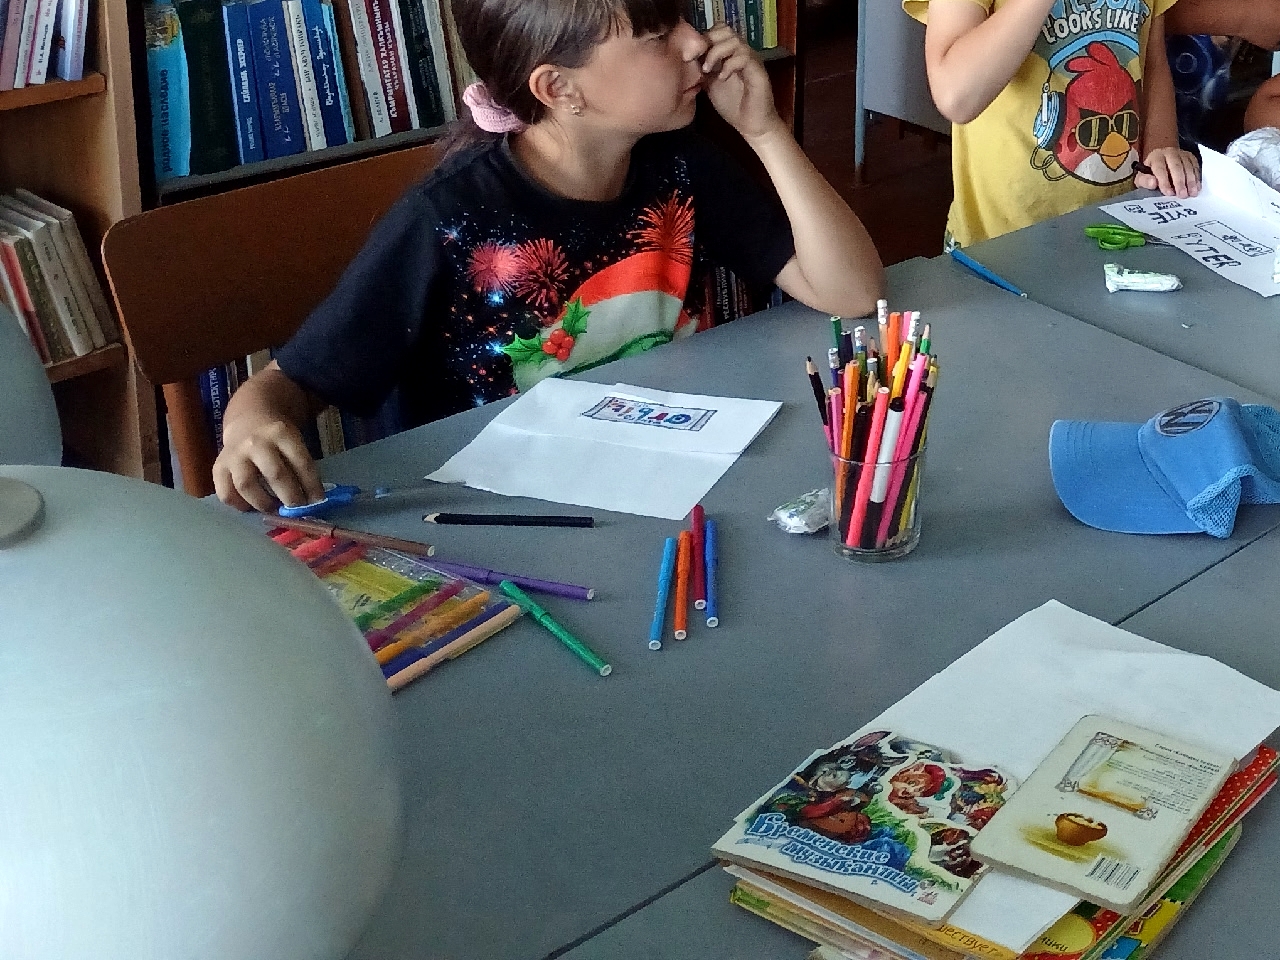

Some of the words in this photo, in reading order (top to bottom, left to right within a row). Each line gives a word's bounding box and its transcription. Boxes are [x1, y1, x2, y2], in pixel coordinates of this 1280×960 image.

[1042, 8, 1103, 44] LOOKS
[1105, 8, 1140, 34] LIKE
[745, 811, 892, 867] Бременские
[781, 840, 920, 895] музыканты
